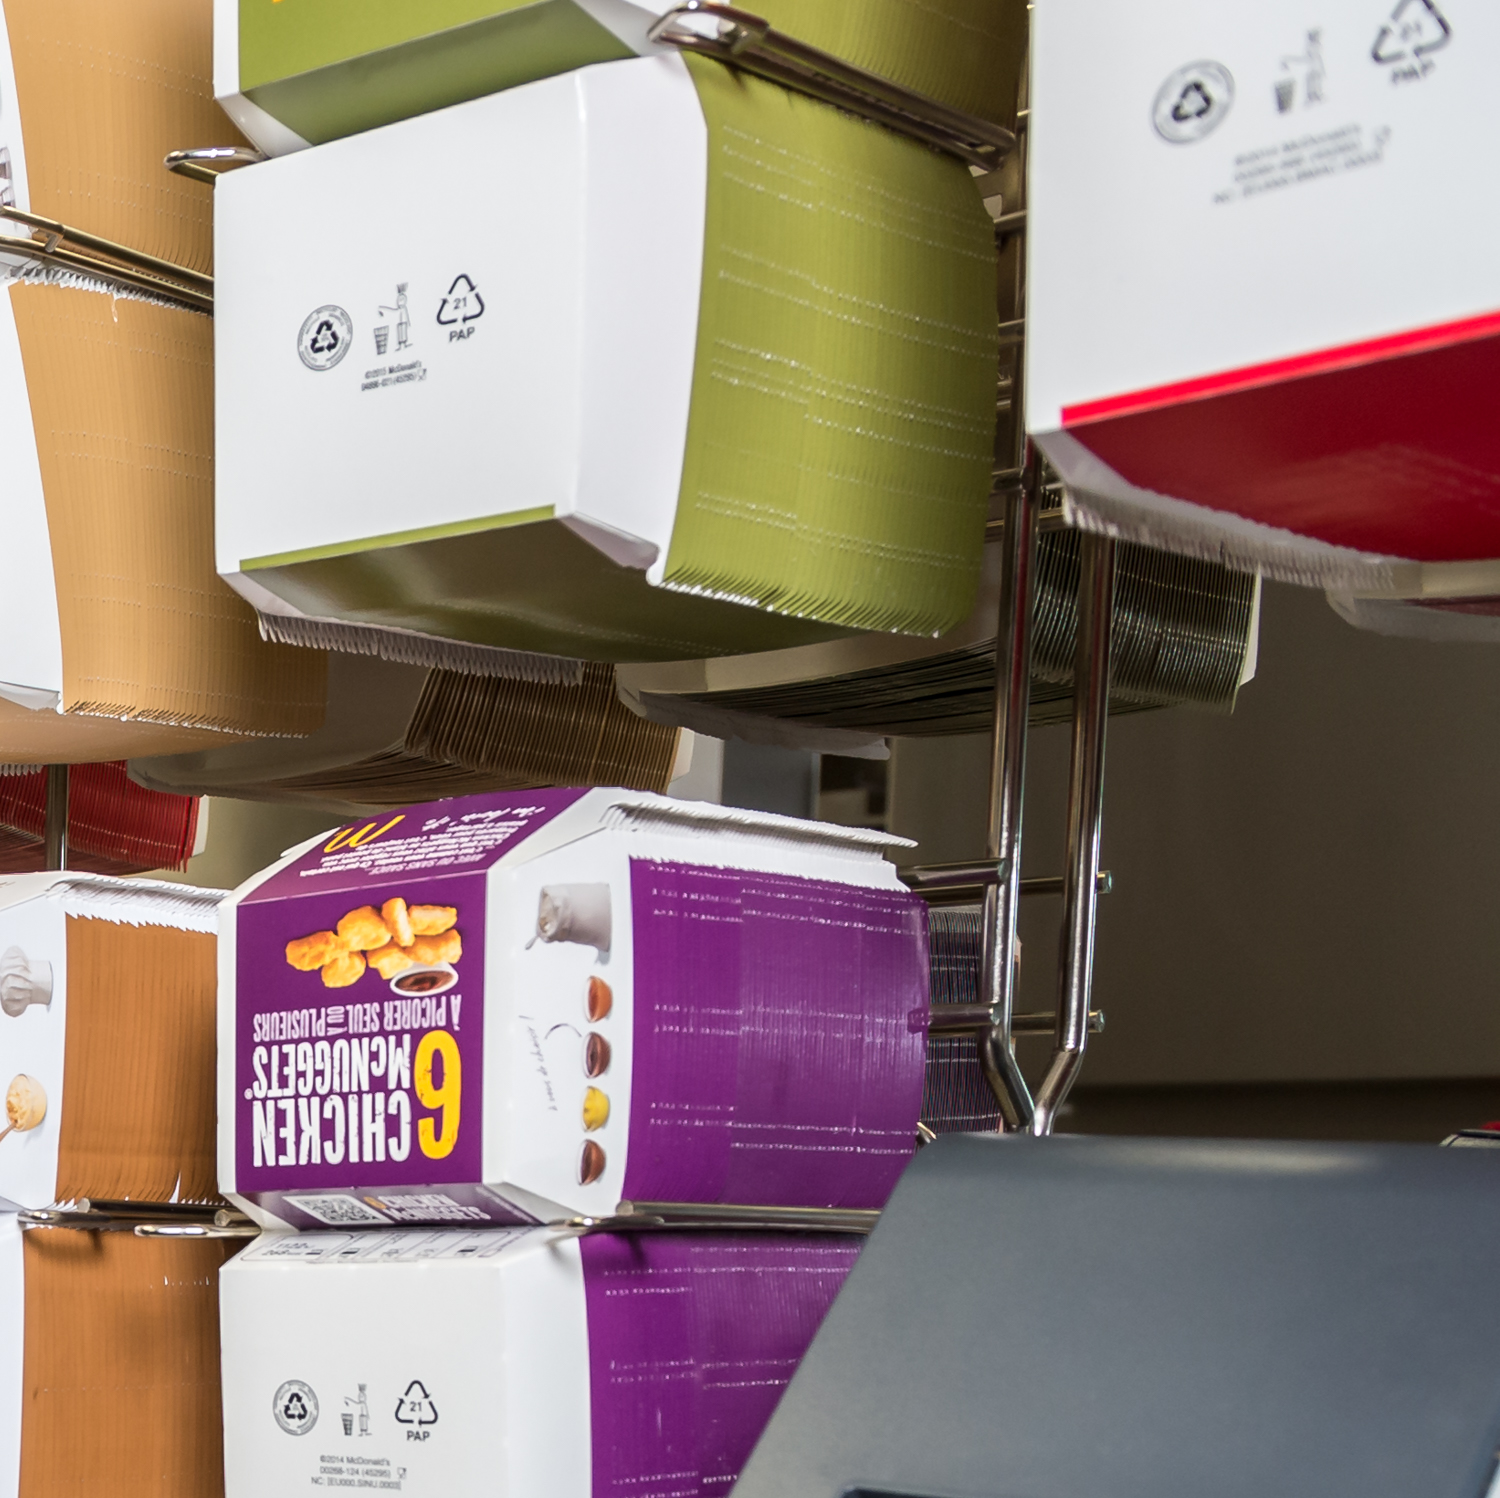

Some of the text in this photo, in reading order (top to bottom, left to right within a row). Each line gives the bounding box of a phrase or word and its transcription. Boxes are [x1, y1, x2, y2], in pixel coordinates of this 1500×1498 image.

[453, 297, 467, 310] 21
[449, 327, 475, 344] PAP
[253, 1007, 326, 1042] PLUSIEURS
[346, 1002, 380, 1034] SEUL
[384, 996, 446, 1032] PICORER
[450, 994, 462, 1031] À
[253, 1030, 462, 1167] 6 CHICKEN
[409, 1401, 422, 1412] 21
[406, 1430, 430, 1442] PAP
[346, 1456, 390, 1466] McDonald's
